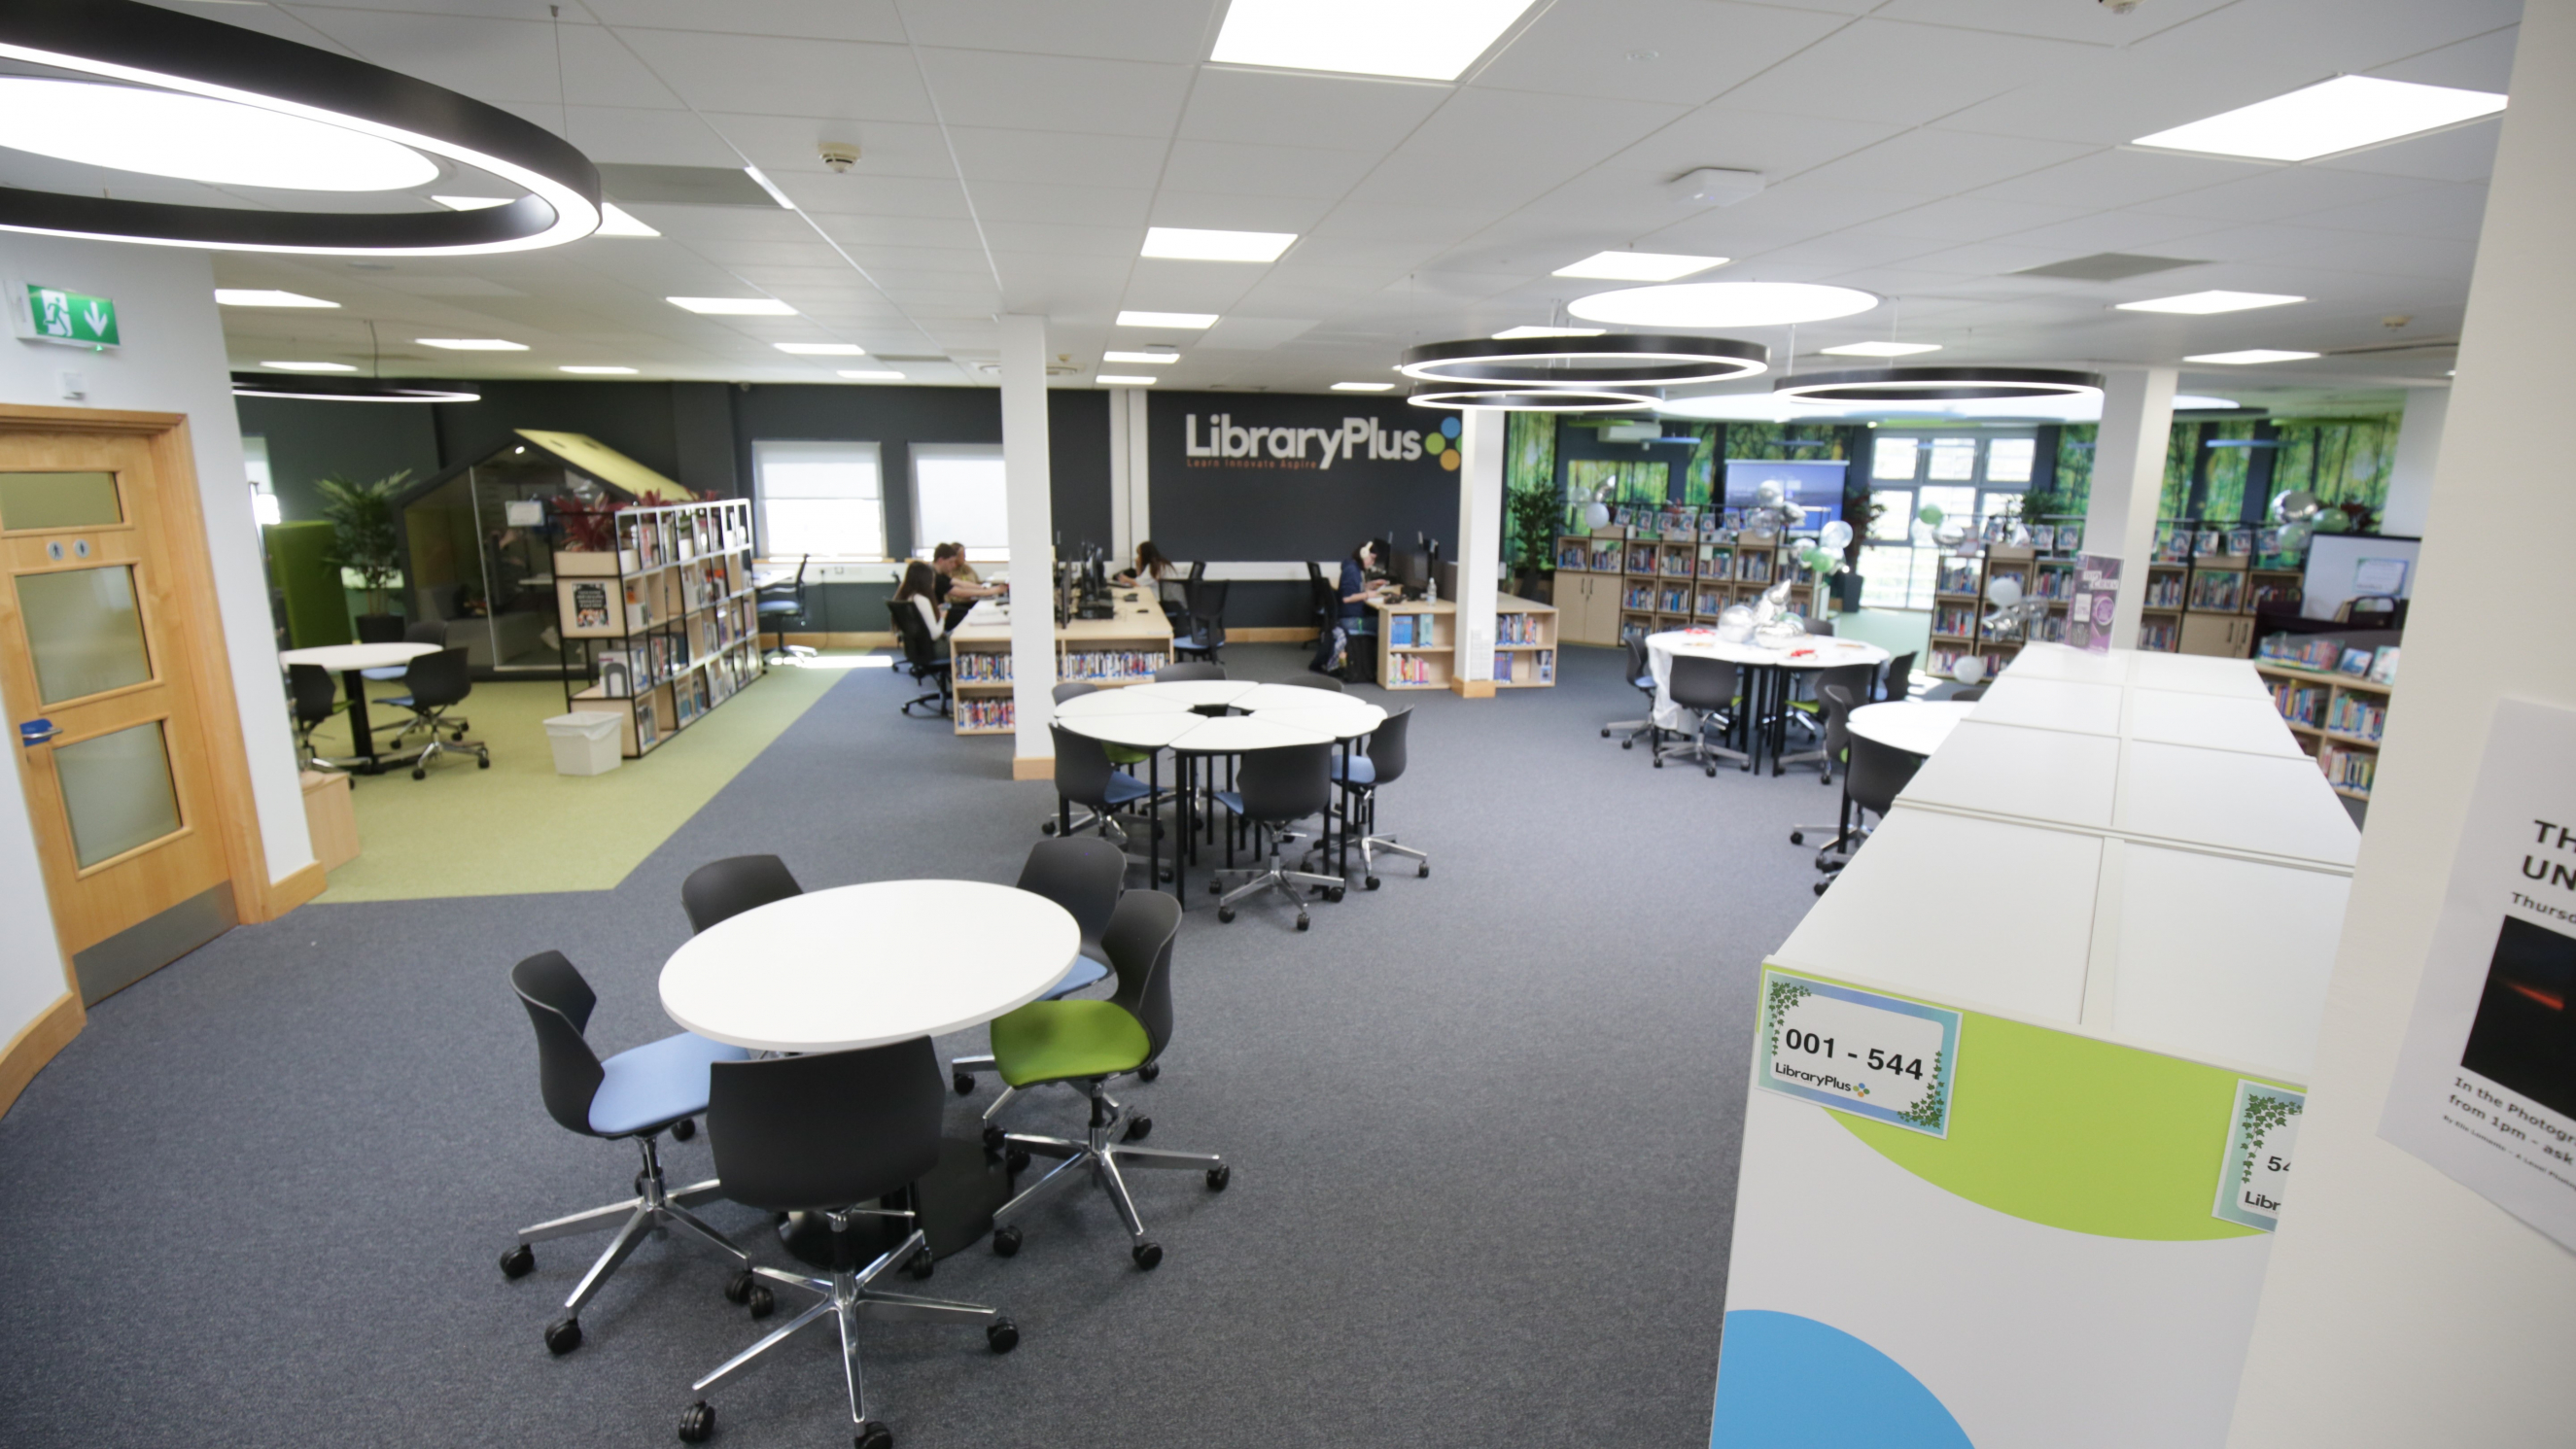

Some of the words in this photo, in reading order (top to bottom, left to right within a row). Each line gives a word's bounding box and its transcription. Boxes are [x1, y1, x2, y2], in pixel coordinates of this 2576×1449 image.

[1186, 414, 1422, 469] LibraryPlus
[1186, 458, 1220, 468] Learn
[1225, 458, 1275, 469] Innovate
[1280, 458, 1317, 470] Aspire
[2523, 854, 2576, 891] UN
[1775, 1062, 1852, 1092] LibraryPlus
[1786, 1028, 1834, 1058] 001
[1867, 1048, 1924, 1081] 544
[2450, 1094, 2486, 1120] from
[2491, 1116, 2525, 1141] 1pm
[2543, 1145, 2574, 1166] ask
[2454, 1076, 2472, 1092] In
[2477, 1087, 2503, 1108] the
[2508, 1102, 2576, 1148] Photogr
[2245, 1190, 2281, 1211] Libr
